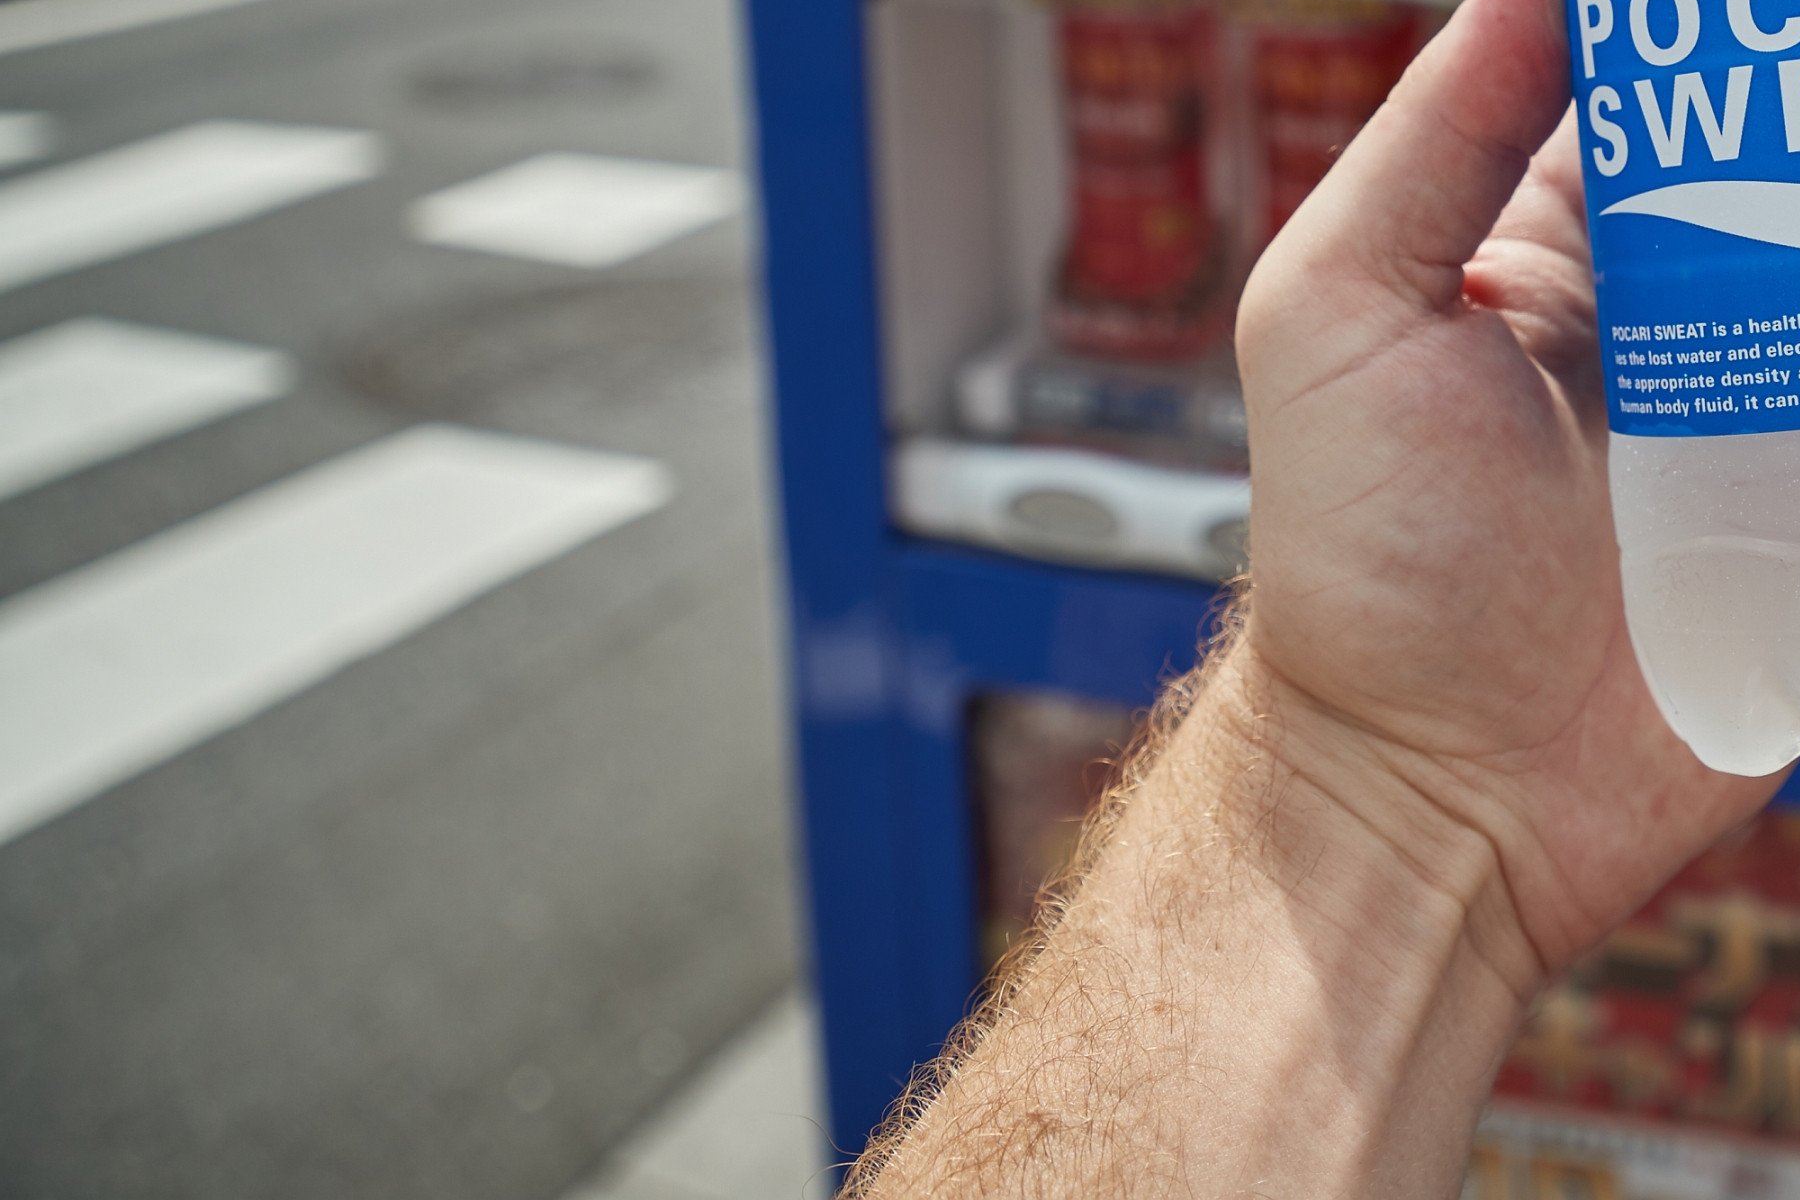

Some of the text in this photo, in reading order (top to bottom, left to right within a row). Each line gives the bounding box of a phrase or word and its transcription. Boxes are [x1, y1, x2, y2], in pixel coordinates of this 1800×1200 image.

[1612, 325, 1651, 341] POCARI
[1654, 322, 1707, 341] SWEAT
[1712, 321, 1727, 337] is
[1732, 323, 1743, 335] a
[1615, 351, 1628, 366] ies
[1628, 350, 1646, 366] the
[1648, 350, 1673, 366] lost
[1676, 349, 1722, 364] water
[1727, 343, 1761, 362] and
[1617, 375, 1632, 390] the
[1634, 373, 1715, 393] appropriate
[1721, 367, 1791, 387] density
[1619, 398, 1653, 414] human
[1655, 399, 1690, 417] body
[1694, 396, 1739, 414] fluid,
[1745, 395, 1758, 410] it
[1764, 393, 1799, 409] can
